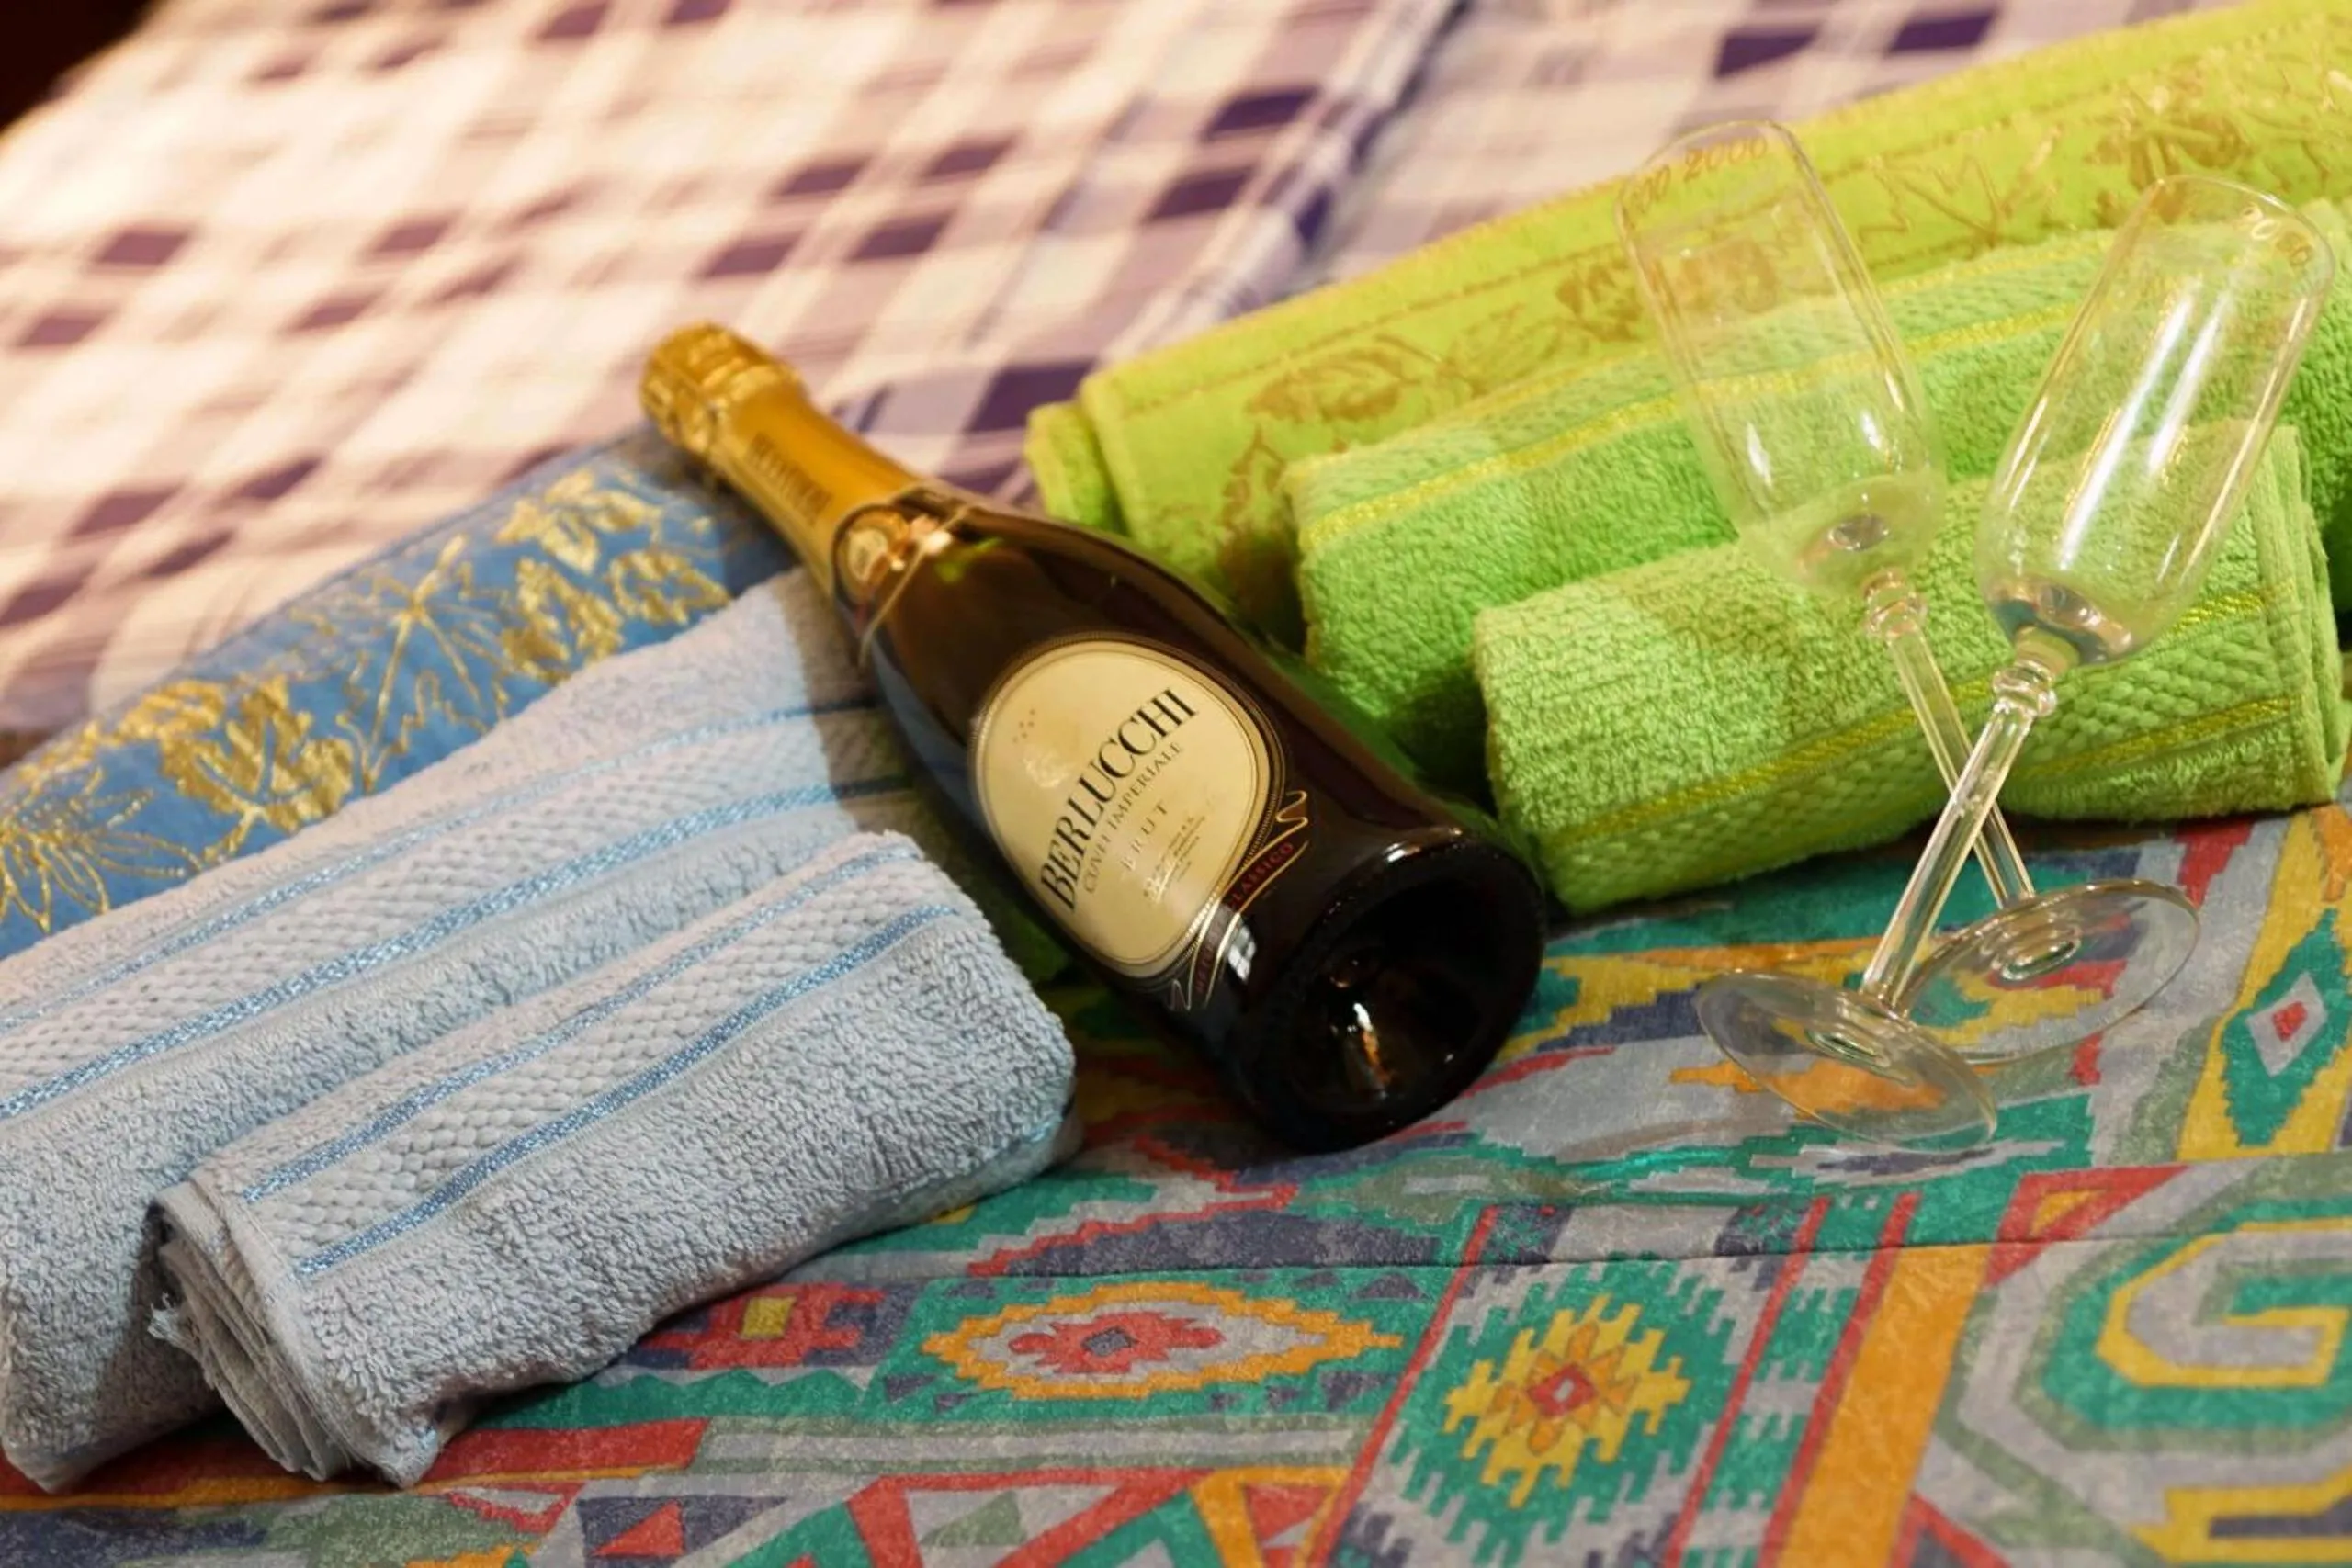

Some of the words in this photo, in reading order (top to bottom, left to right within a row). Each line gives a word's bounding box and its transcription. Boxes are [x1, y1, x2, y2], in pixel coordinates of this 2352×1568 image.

[1683, 136, 1769, 185] 2000
[1038, 687, 1199, 912] BERLUCCHI
[1106, 741, 1182, 830] IMPERIALE
[1119, 799, 1168, 872] BRUT
